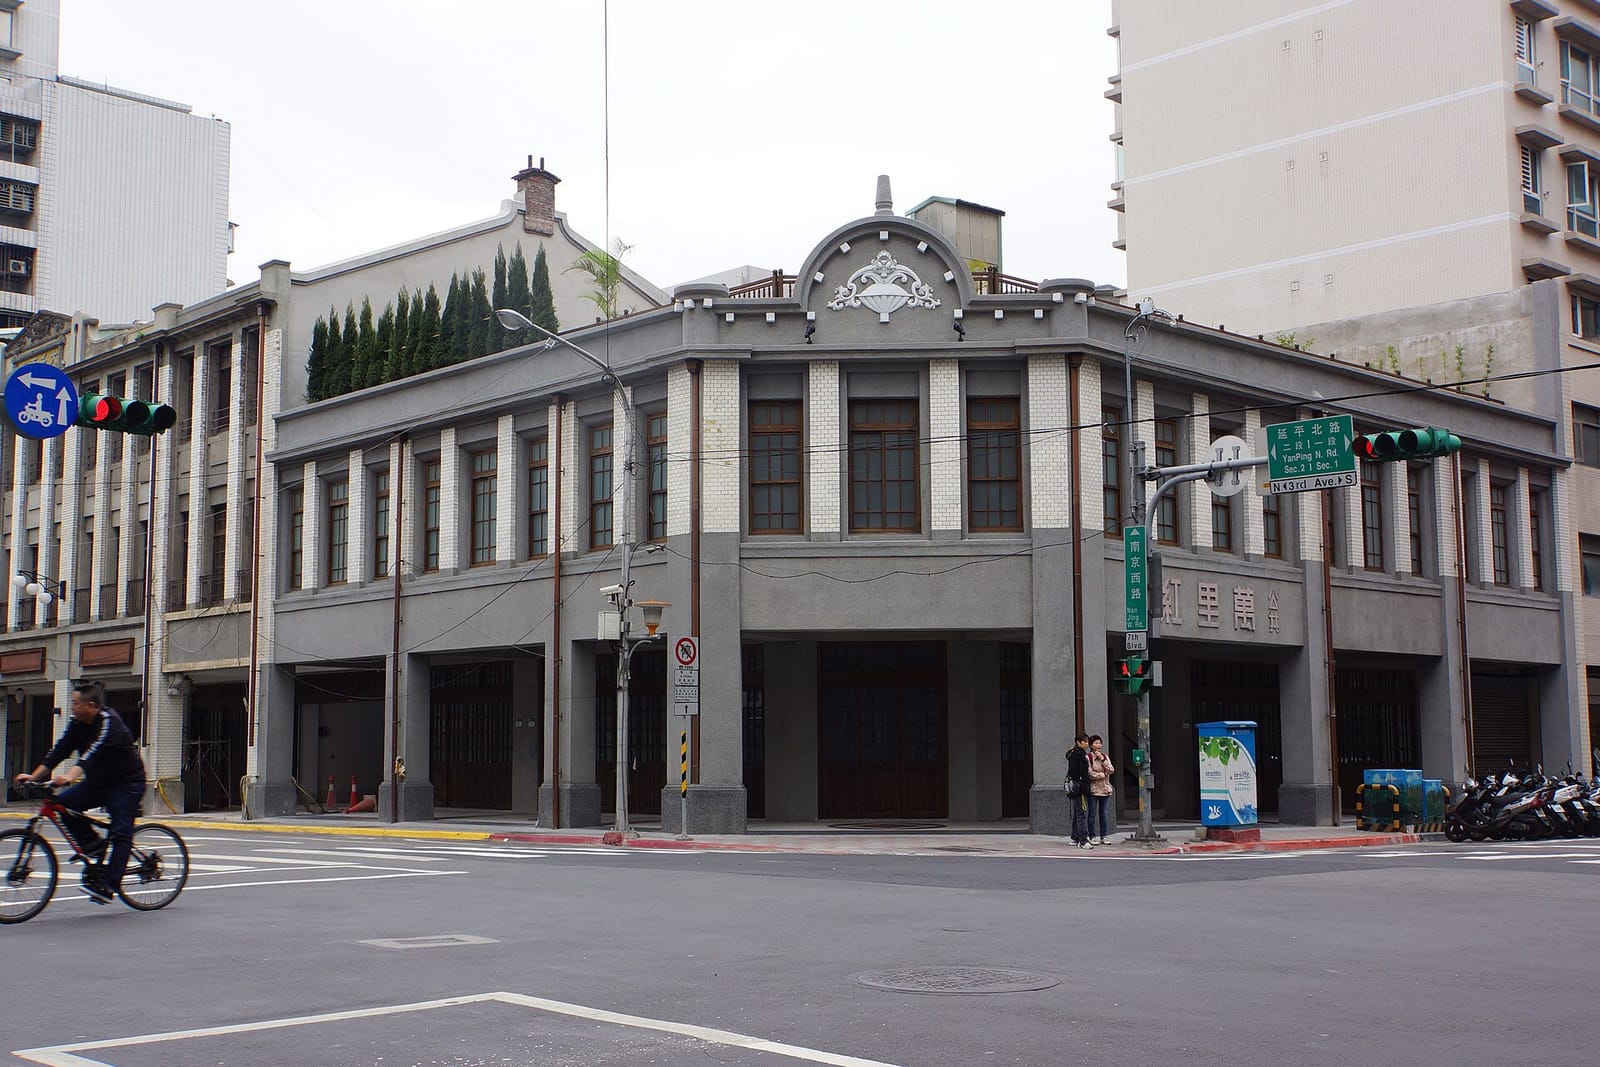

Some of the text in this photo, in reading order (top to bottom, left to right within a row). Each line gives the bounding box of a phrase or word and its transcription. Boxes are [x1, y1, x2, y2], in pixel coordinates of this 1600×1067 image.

[1277, 421, 1340, 440] 延平北路
[1283, 436, 1336, 451] 二段 一段
[1282, 452, 1312, 463] YanPing
[1326, 448, 1339, 457] Rd.
[1273, 474, 1353, 492] N 3rd Ave. S
[1130, 541, 1141, 599] 南京西路
[1127, 633, 1139, 641] 7th
[1126, 642, 1144, 650] Blvd.
